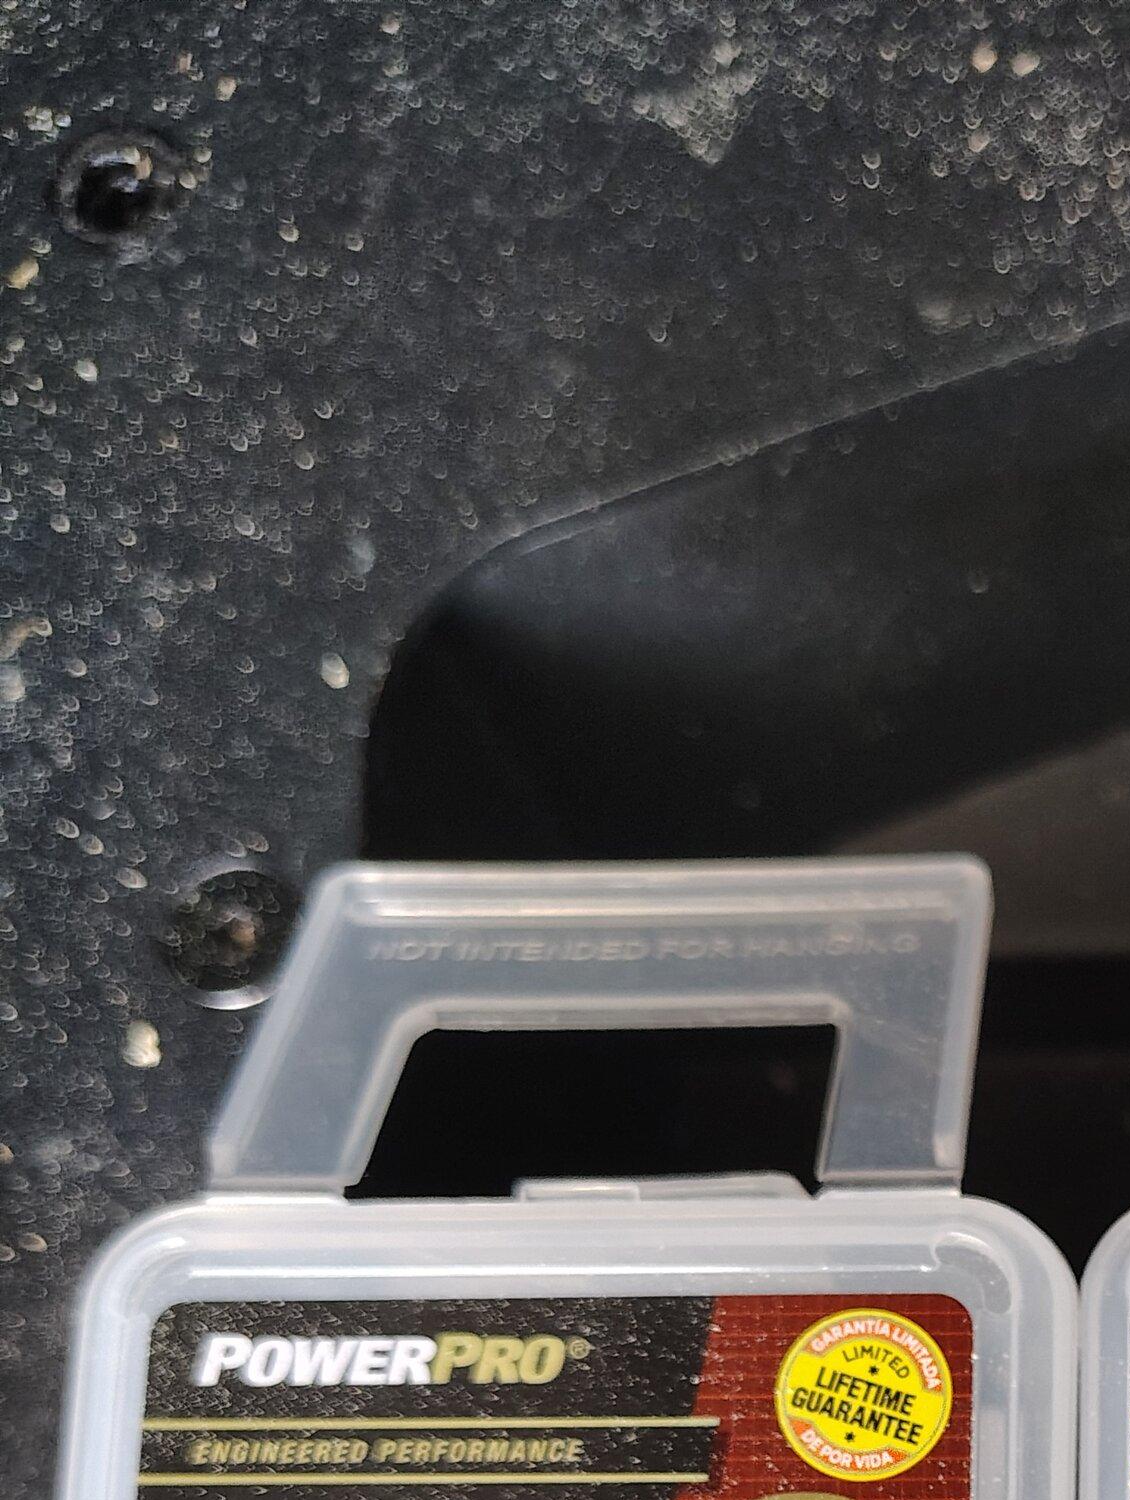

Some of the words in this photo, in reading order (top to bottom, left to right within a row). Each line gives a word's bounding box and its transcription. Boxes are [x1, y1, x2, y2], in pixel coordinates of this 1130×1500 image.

[842, 1344, 911, 1380] LIMITED
[815, 1365, 917, 1416] LIFETIME
[791, 1386, 924, 1445] GUARANTEE
[189, 1439, 369, 1466] ENGINEERED
[373, 1436, 585, 1464] PERFORMANCE
[800, 1428, 821, 1451] DE
[821, 1445, 853, 1468] POR
[854, 1450, 894, 1469] VIDA
